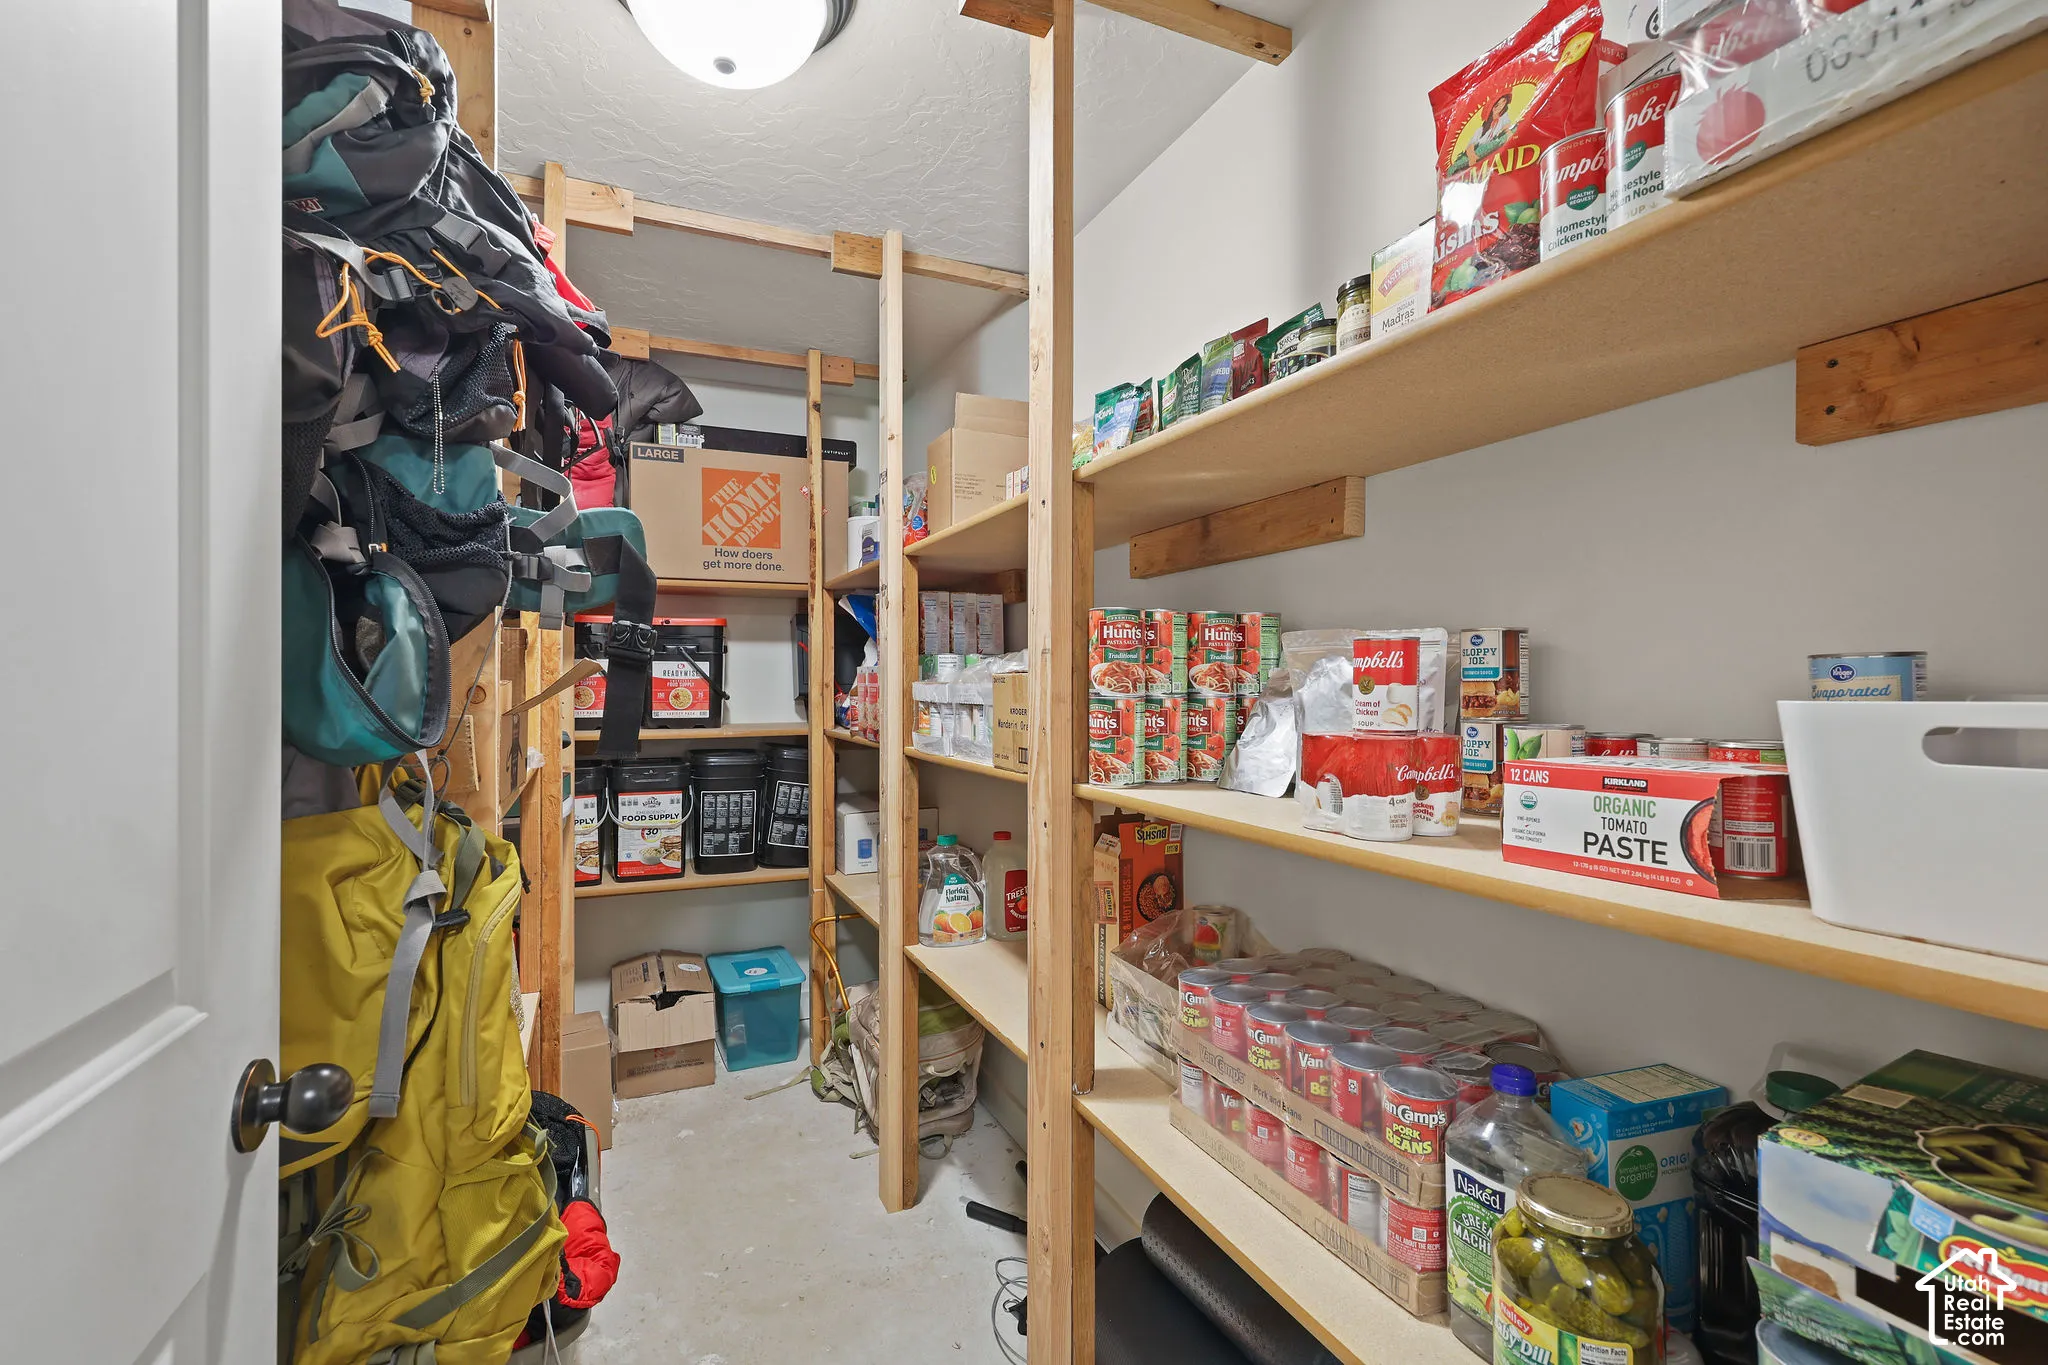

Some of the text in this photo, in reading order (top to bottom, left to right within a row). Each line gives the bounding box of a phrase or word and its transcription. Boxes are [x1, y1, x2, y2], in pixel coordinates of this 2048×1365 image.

[1569, 190, 1596, 201] HEALTHY
[1633, 183, 1665, 204] Nood
[1584, 228, 1607, 241] Noo
[1382, 308, 1415, 331] Madras
[1340, 330, 1370, 346] ASPARAG
[637, 447, 679, 460] LARGE
[710, 477, 744, 508] THE
[702, 472, 781, 546] HOME
[733, 501, 781, 547] DEPOT
[715, 548, 773, 559] How doers
[702, 560, 785, 572] get more done.
[1103, 625, 1142, 640] Hunt's
[1462, 648, 1497, 657] SLOPPY
[1468, 656, 1485, 665] JOE
[1353, 651, 1404, 672] mpbell's
[1832, 666, 1853, 680] Kroger
[1811, 684, 1892, 701] Evaporated
[1010, 707, 1027, 716] KROGER
[1355, 708, 1379, 716] Chicken
[1373, 700, 1380, 708] of
[1145, 714, 1167, 730] nt's
[1188, 714, 1210, 730] nt's
[1465, 748, 1480, 757] JOE
[1395, 763, 1456, 784] Campbell's
[1510, 768, 1550, 784] 12 CANS
[1604, 778, 1647, 788] KIRKLAND
[1388, 797, 1396, 807] 4
[1593, 795, 1657, 818] ORGANIC
[574, 817, 595, 826] PPLY
[648, 813, 680, 821] SUPPLY
[646, 828, 659, 836] 30
[1601, 816, 1648, 836] TOMATO
[1583, 831, 1668, 866] PASTE
[945, 886, 969, 896] Florida's
[945, 893, 969, 903] Natural
[1006, 891, 1025, 901] TREE
[1105, 888, 1113, 917] BUSH'S
[1252, 1045, 1271, 1058] PORK
[1298, 1050, 1324, 1068] Van
[1248, 1051, 1281, 1070] BEANS
[1399, 1104, 1447, 1128] Camp's
[1392, 1123, 1420, 1140] PORK
[1386, 1127, 1433, 1155] BEANS
[1619, 1170, 1656, 1184] organic
[1457, 1173, 1502, 1211] Naked
[1395, 1233, 1403, 1243] ALL
[1403, 1237, 1418, 1249] ABOUT
[1418, 1241, 1427, 1250] THE
[1453, 1221, 1491, 1256] MACHI
[1501, 1303, 1530, 1334] Nalley
[1520, 1338, 1552, 1365] Dill
[1581, 1342, 1627, 1357] Nutrition Facts
